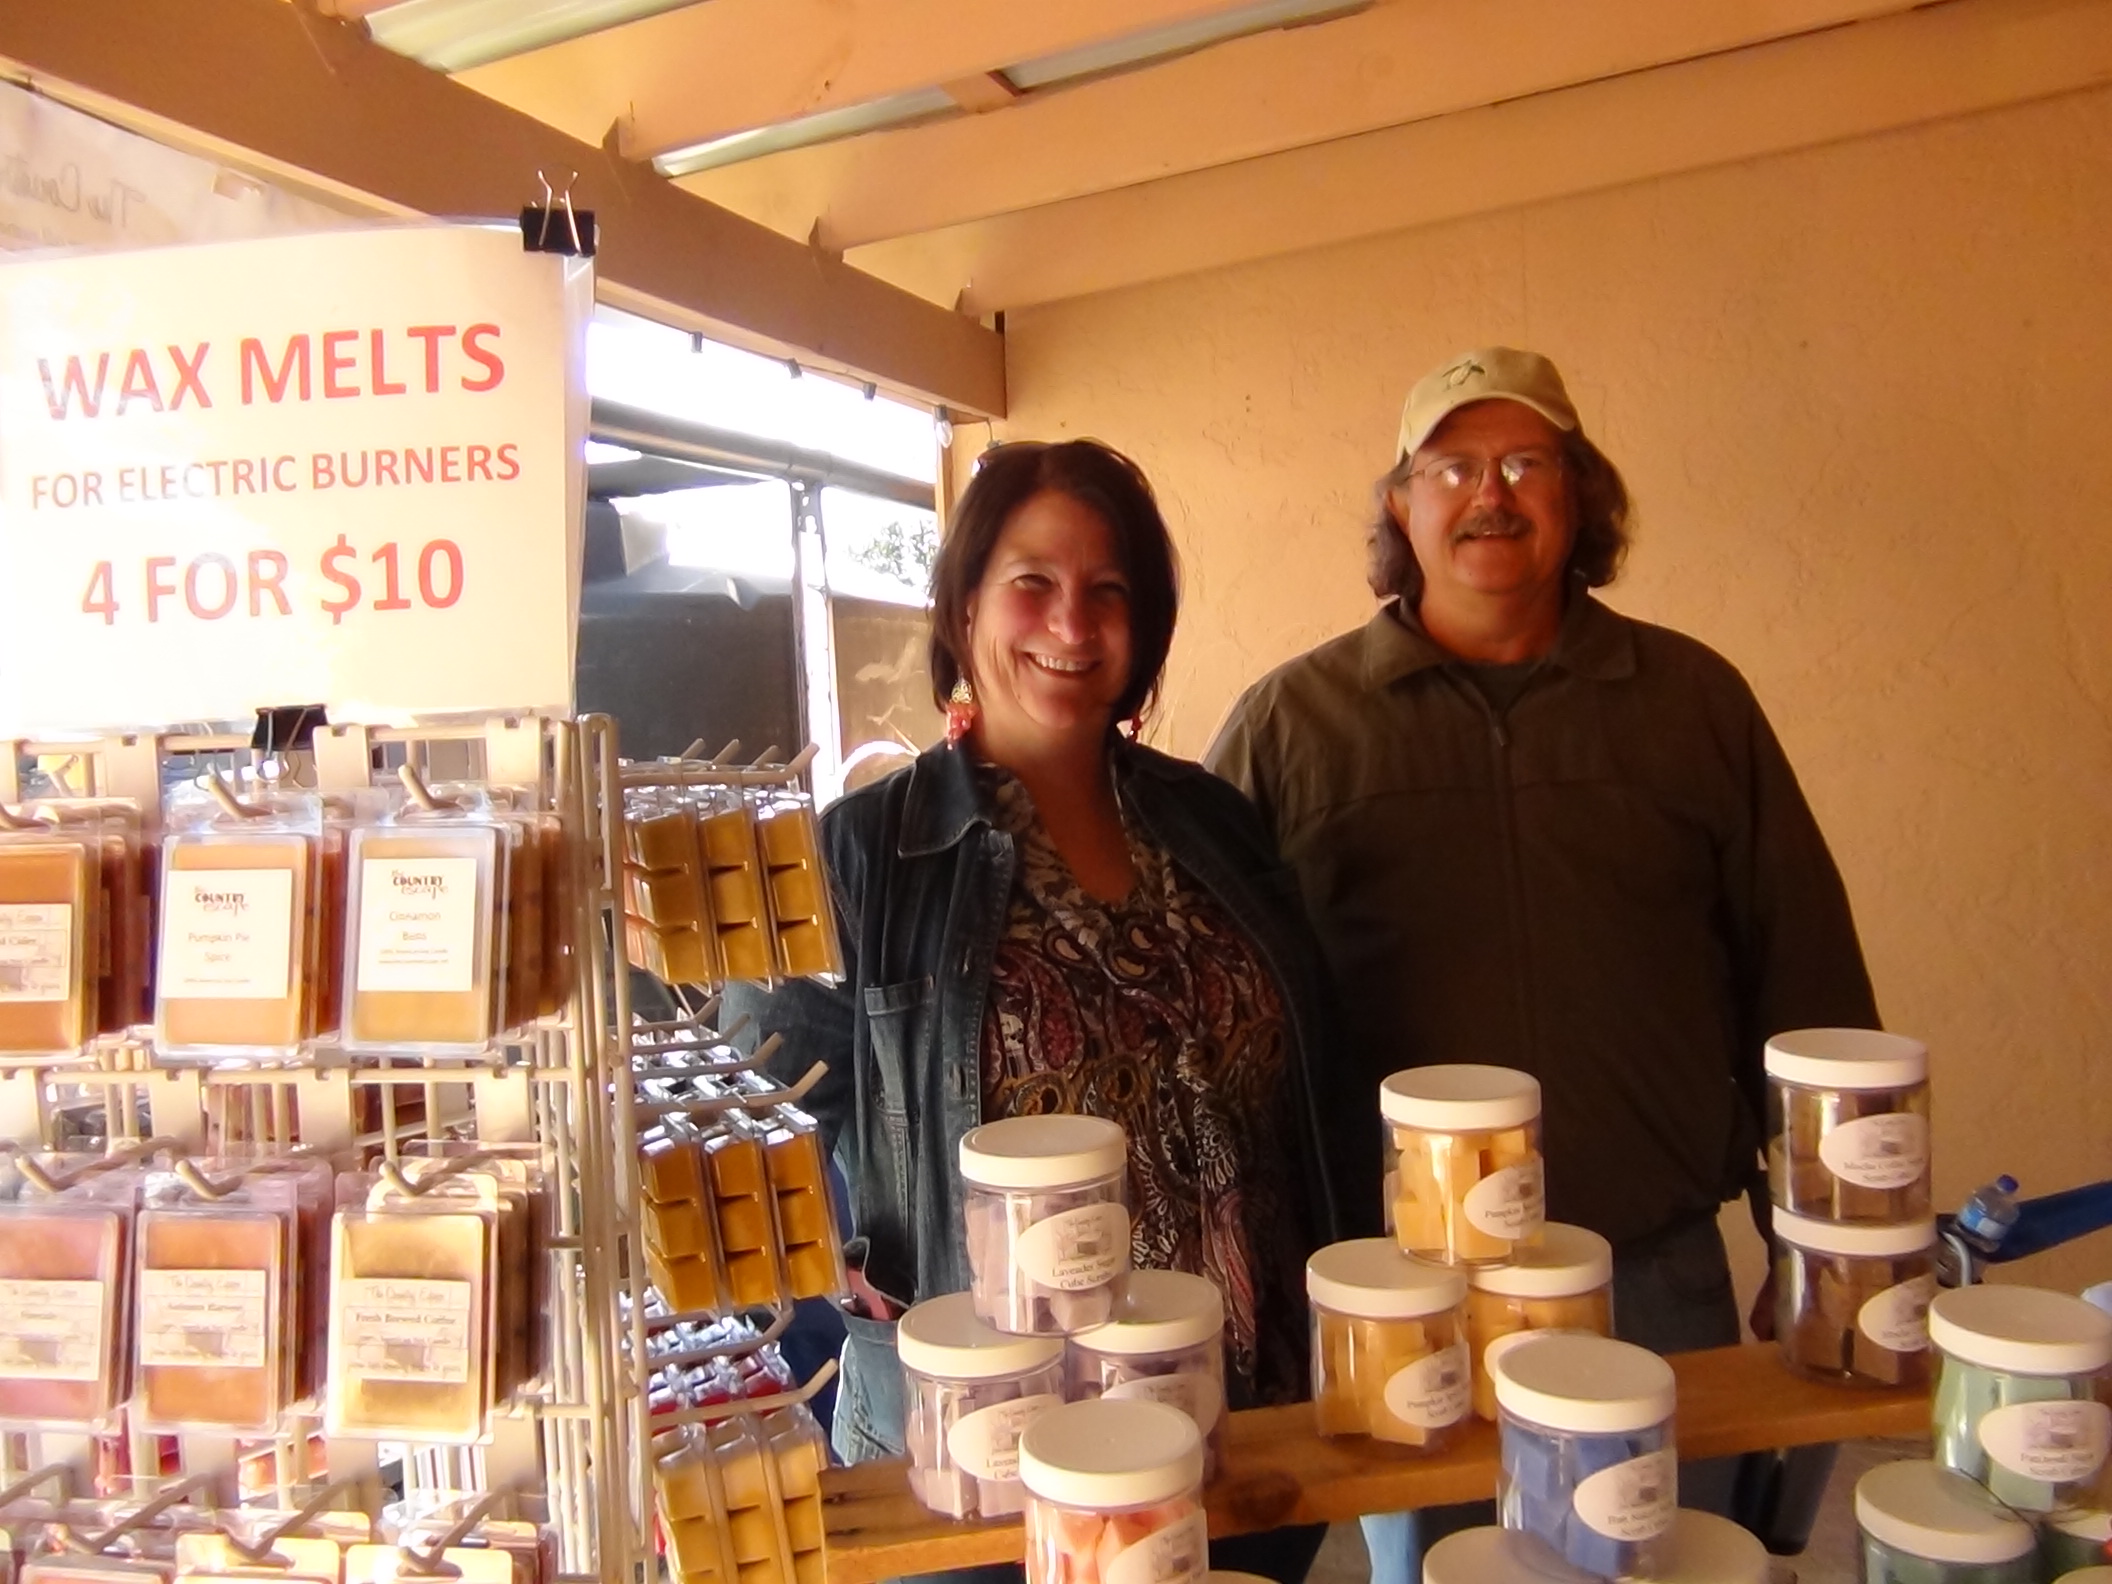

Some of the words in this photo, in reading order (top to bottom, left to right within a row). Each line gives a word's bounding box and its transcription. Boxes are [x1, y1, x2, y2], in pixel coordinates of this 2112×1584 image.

[37, 341, 213, 421] WAX
[240, 322, 506, 405] MELTS
[31, 471, 104, 510] FOR
[118, 455, 297, 502] ELECTRIC
[311, 443, 521, 490] BURNERS
[81, 560, 120, 626] 4
[145, 549, 293, 623] FOR
[319, 533, 465, 626] $10
[392, 875, 443, 887] COUNTRY
[194, 892, 245, 904] COUNTRY
[188, 932, 232, 943] Pumpkin
[235, 932, 250, 942] Pie
[1052, 1262, 1094, 1278] Lavender
